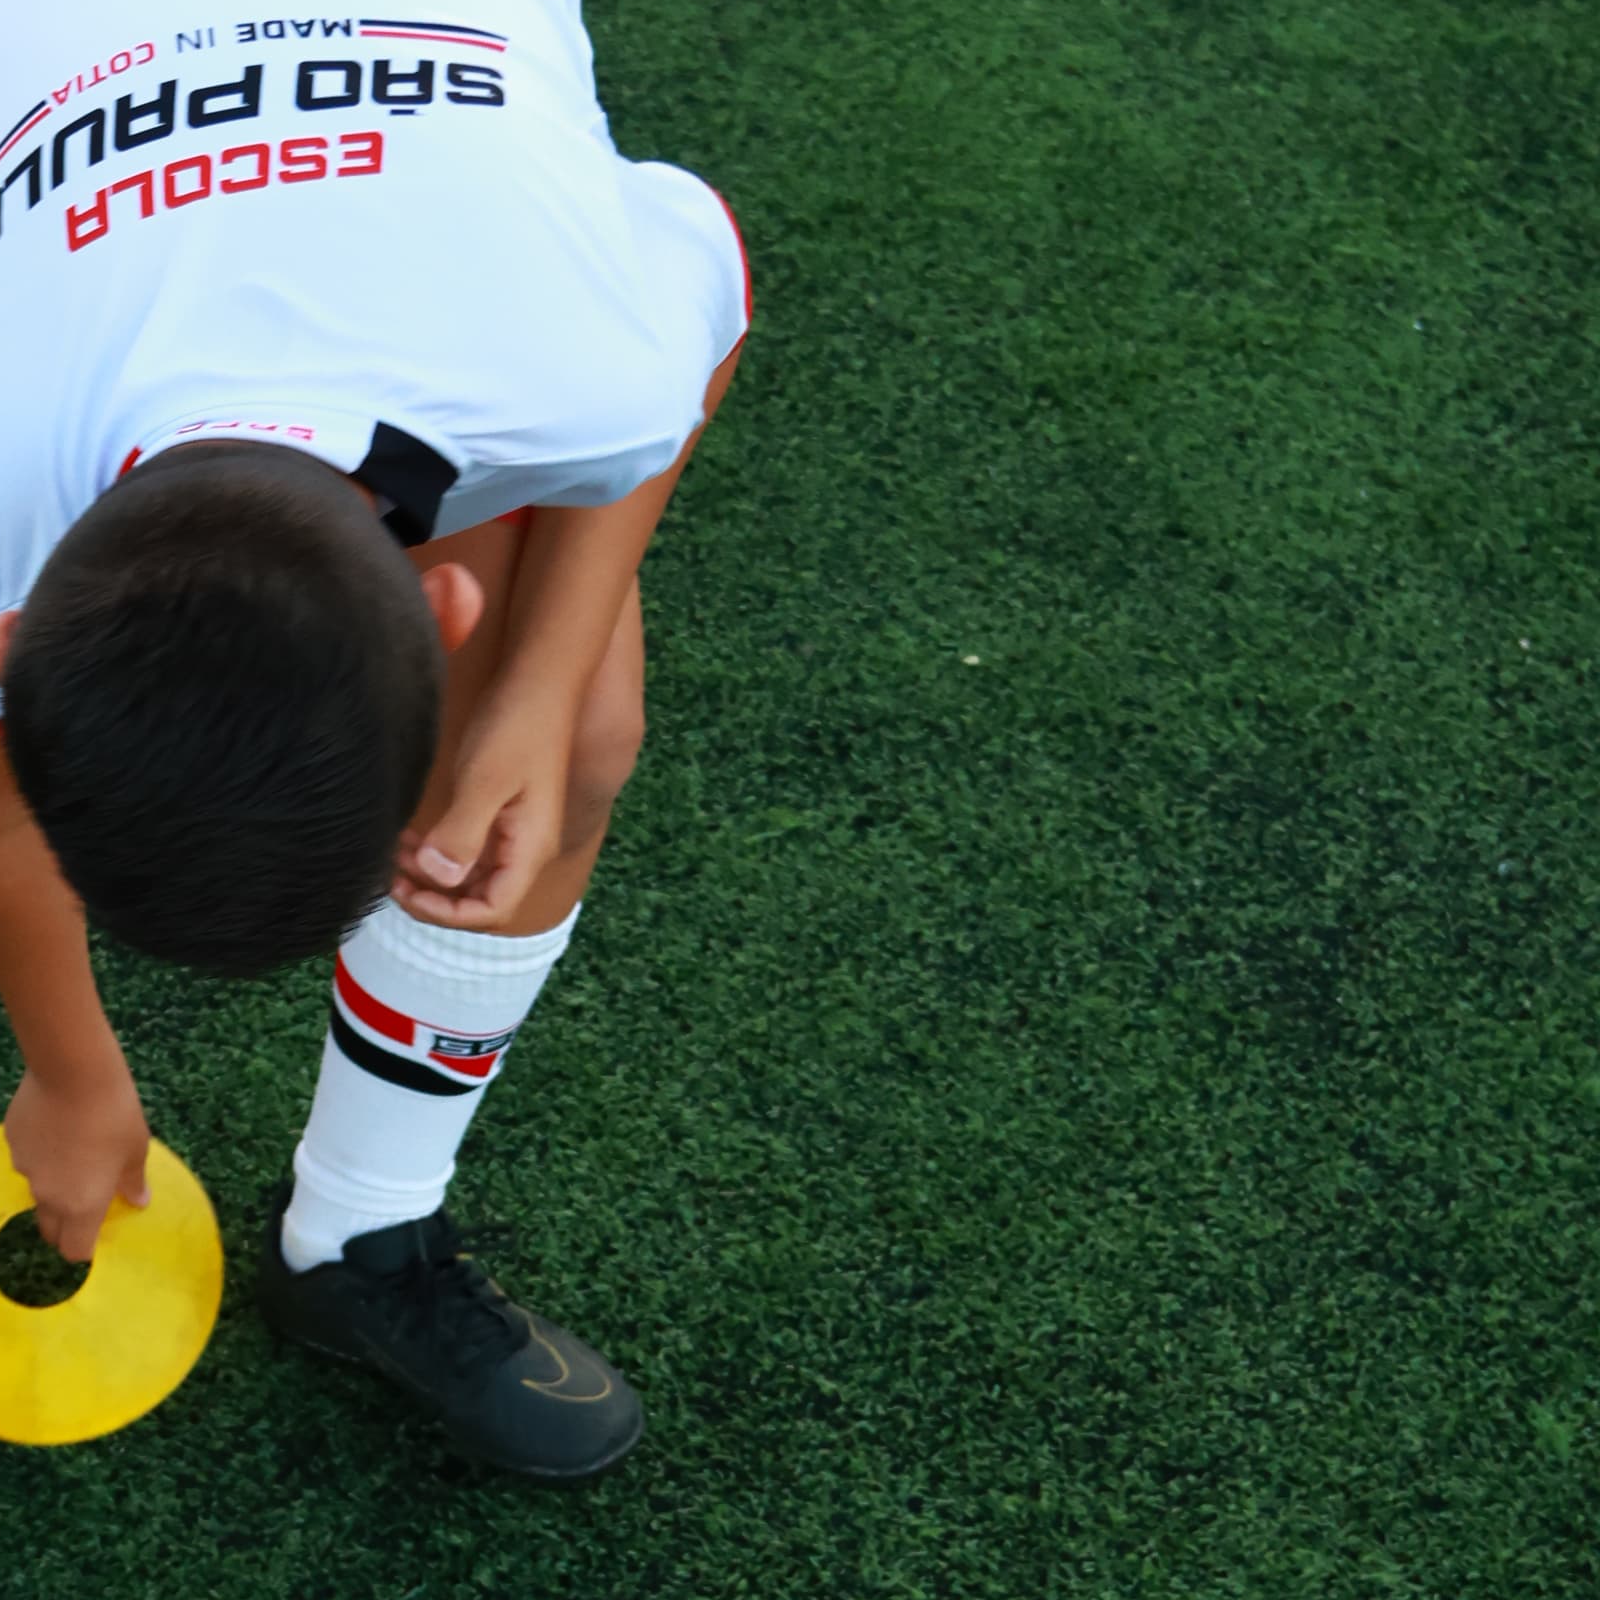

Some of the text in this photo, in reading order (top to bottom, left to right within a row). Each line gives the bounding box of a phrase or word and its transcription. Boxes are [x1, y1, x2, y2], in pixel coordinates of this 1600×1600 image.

[51, 18, 353, 105] MADE IN COTIA
[293, 58, 505, 117] SÃO
[65, 131, 384, 253] ESCOLA
